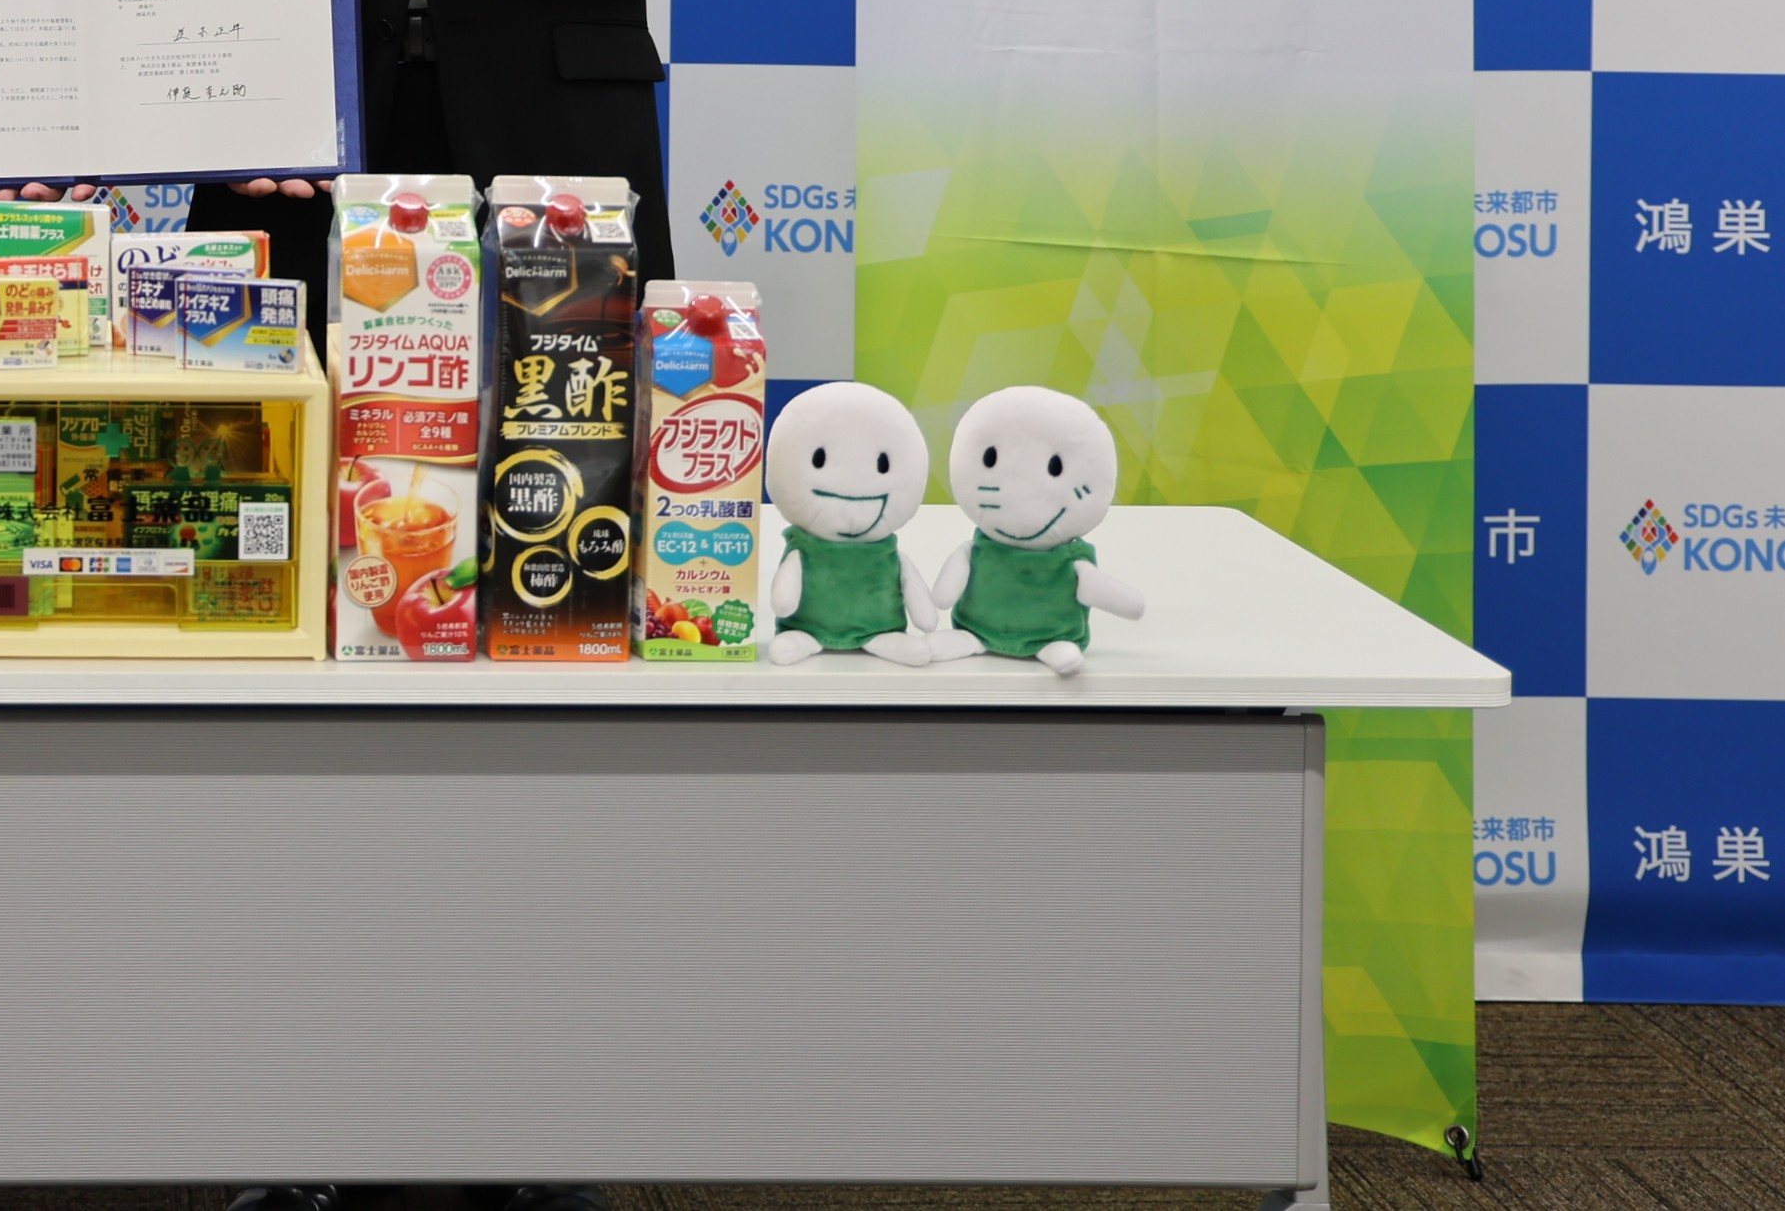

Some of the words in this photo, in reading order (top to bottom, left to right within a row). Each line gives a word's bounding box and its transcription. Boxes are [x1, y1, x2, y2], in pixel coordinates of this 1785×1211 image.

[765, 184, 838, 209] SDGs
[261, 288, 295, 306] 頭痛
[261, 307, 295, 325] 発熱
[349, 335, 414, 351] フジタイム
[418, 334, 470, 352] AQUA
[530, 334, 598, 352] フジタイム
[348, 353, 469, 390] リンゴ酢
[504, 355, 628, 422] 黒酢
[349, 409, 393, 421] ミネラル
[517, 424, 612, 437] プレミアムブレンド
[663, 418, 756, 451] フジラクト
[682, 451, 734, 478] プラス
[508, 488, 559, 513] 黒酢
[656, 496, 753, 518] 2つの乳酸菌
[1685, 504, 1758, 528] SDGs
[657, 541, 697, 553] EC-12
[713, 542, 748, 554] KT-11
[29, 560, 53, 569] VISA
[675, 569, 730, 580] カルシウム
[423, 642, 469, 655] 1800mL
[579, 643, 622, 655] 1800mL
